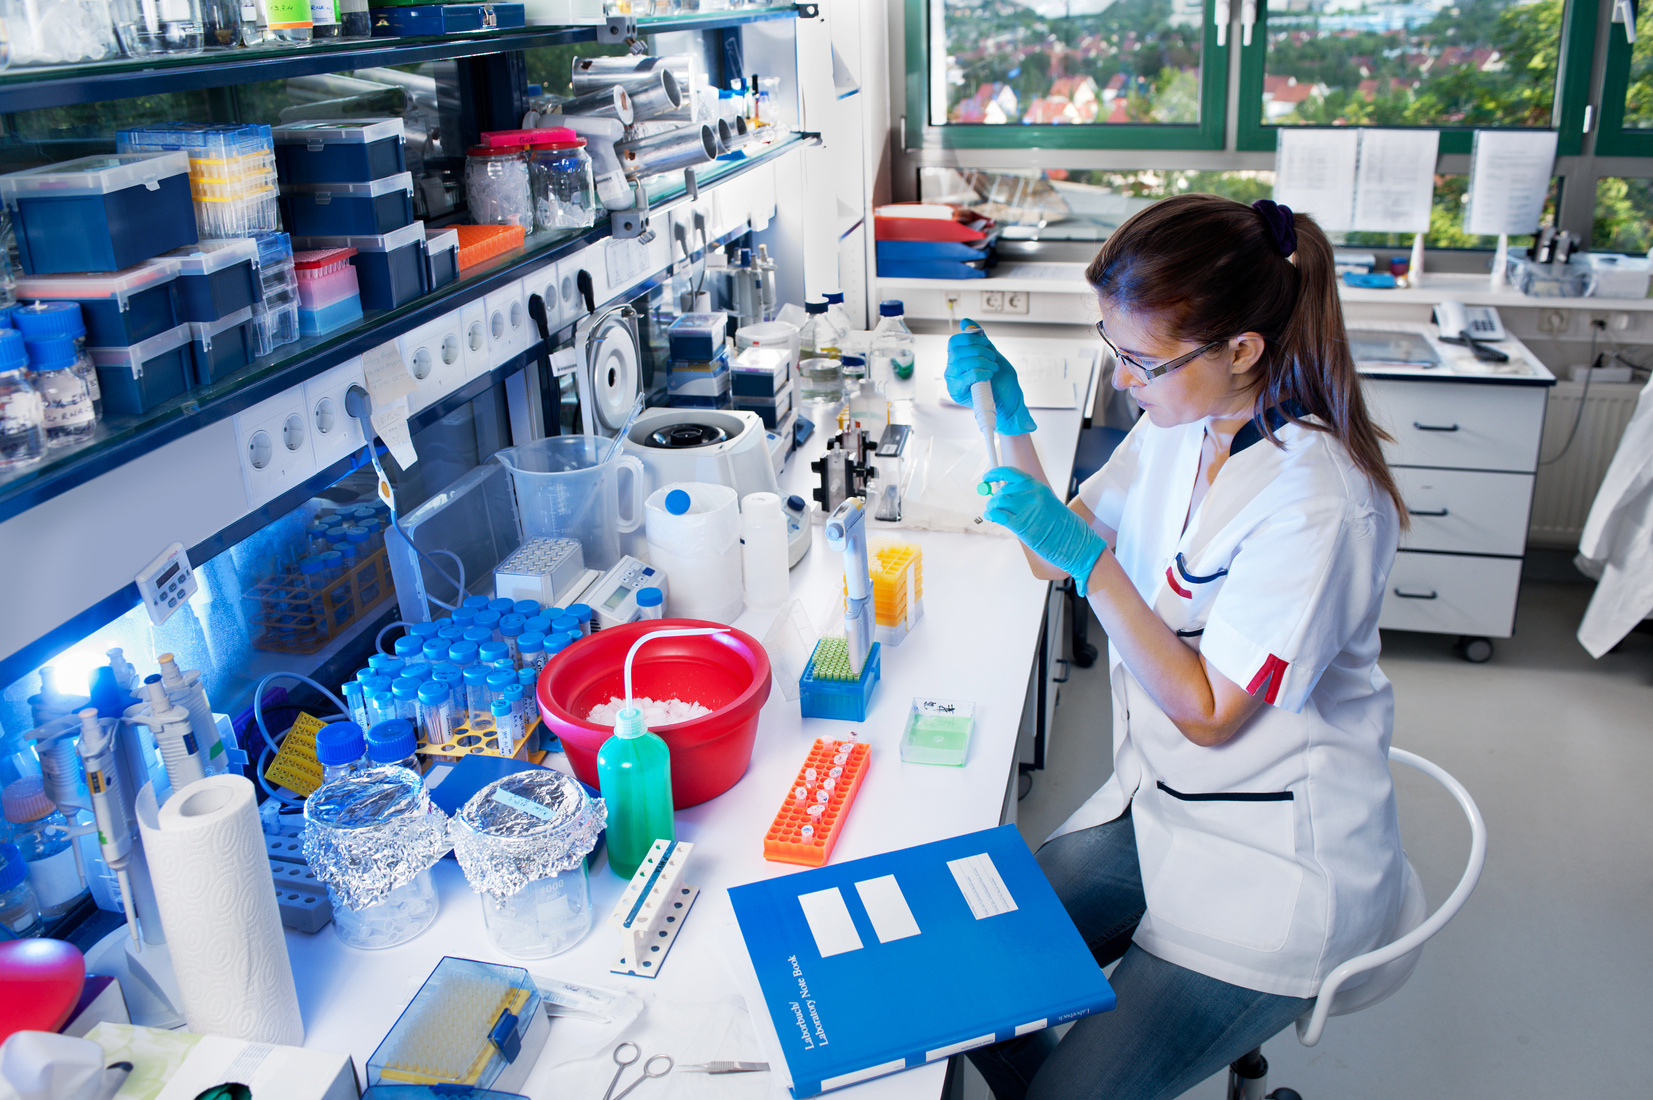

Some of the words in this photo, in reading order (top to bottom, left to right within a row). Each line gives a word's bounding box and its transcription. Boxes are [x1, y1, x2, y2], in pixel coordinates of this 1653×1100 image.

[787, 954, 803, 977] Book
[797, 977, 811, 999] Note
[788, 1001, 815, 1050] Laborbuch/
[805, 999, 829, 1047] Laboratory
